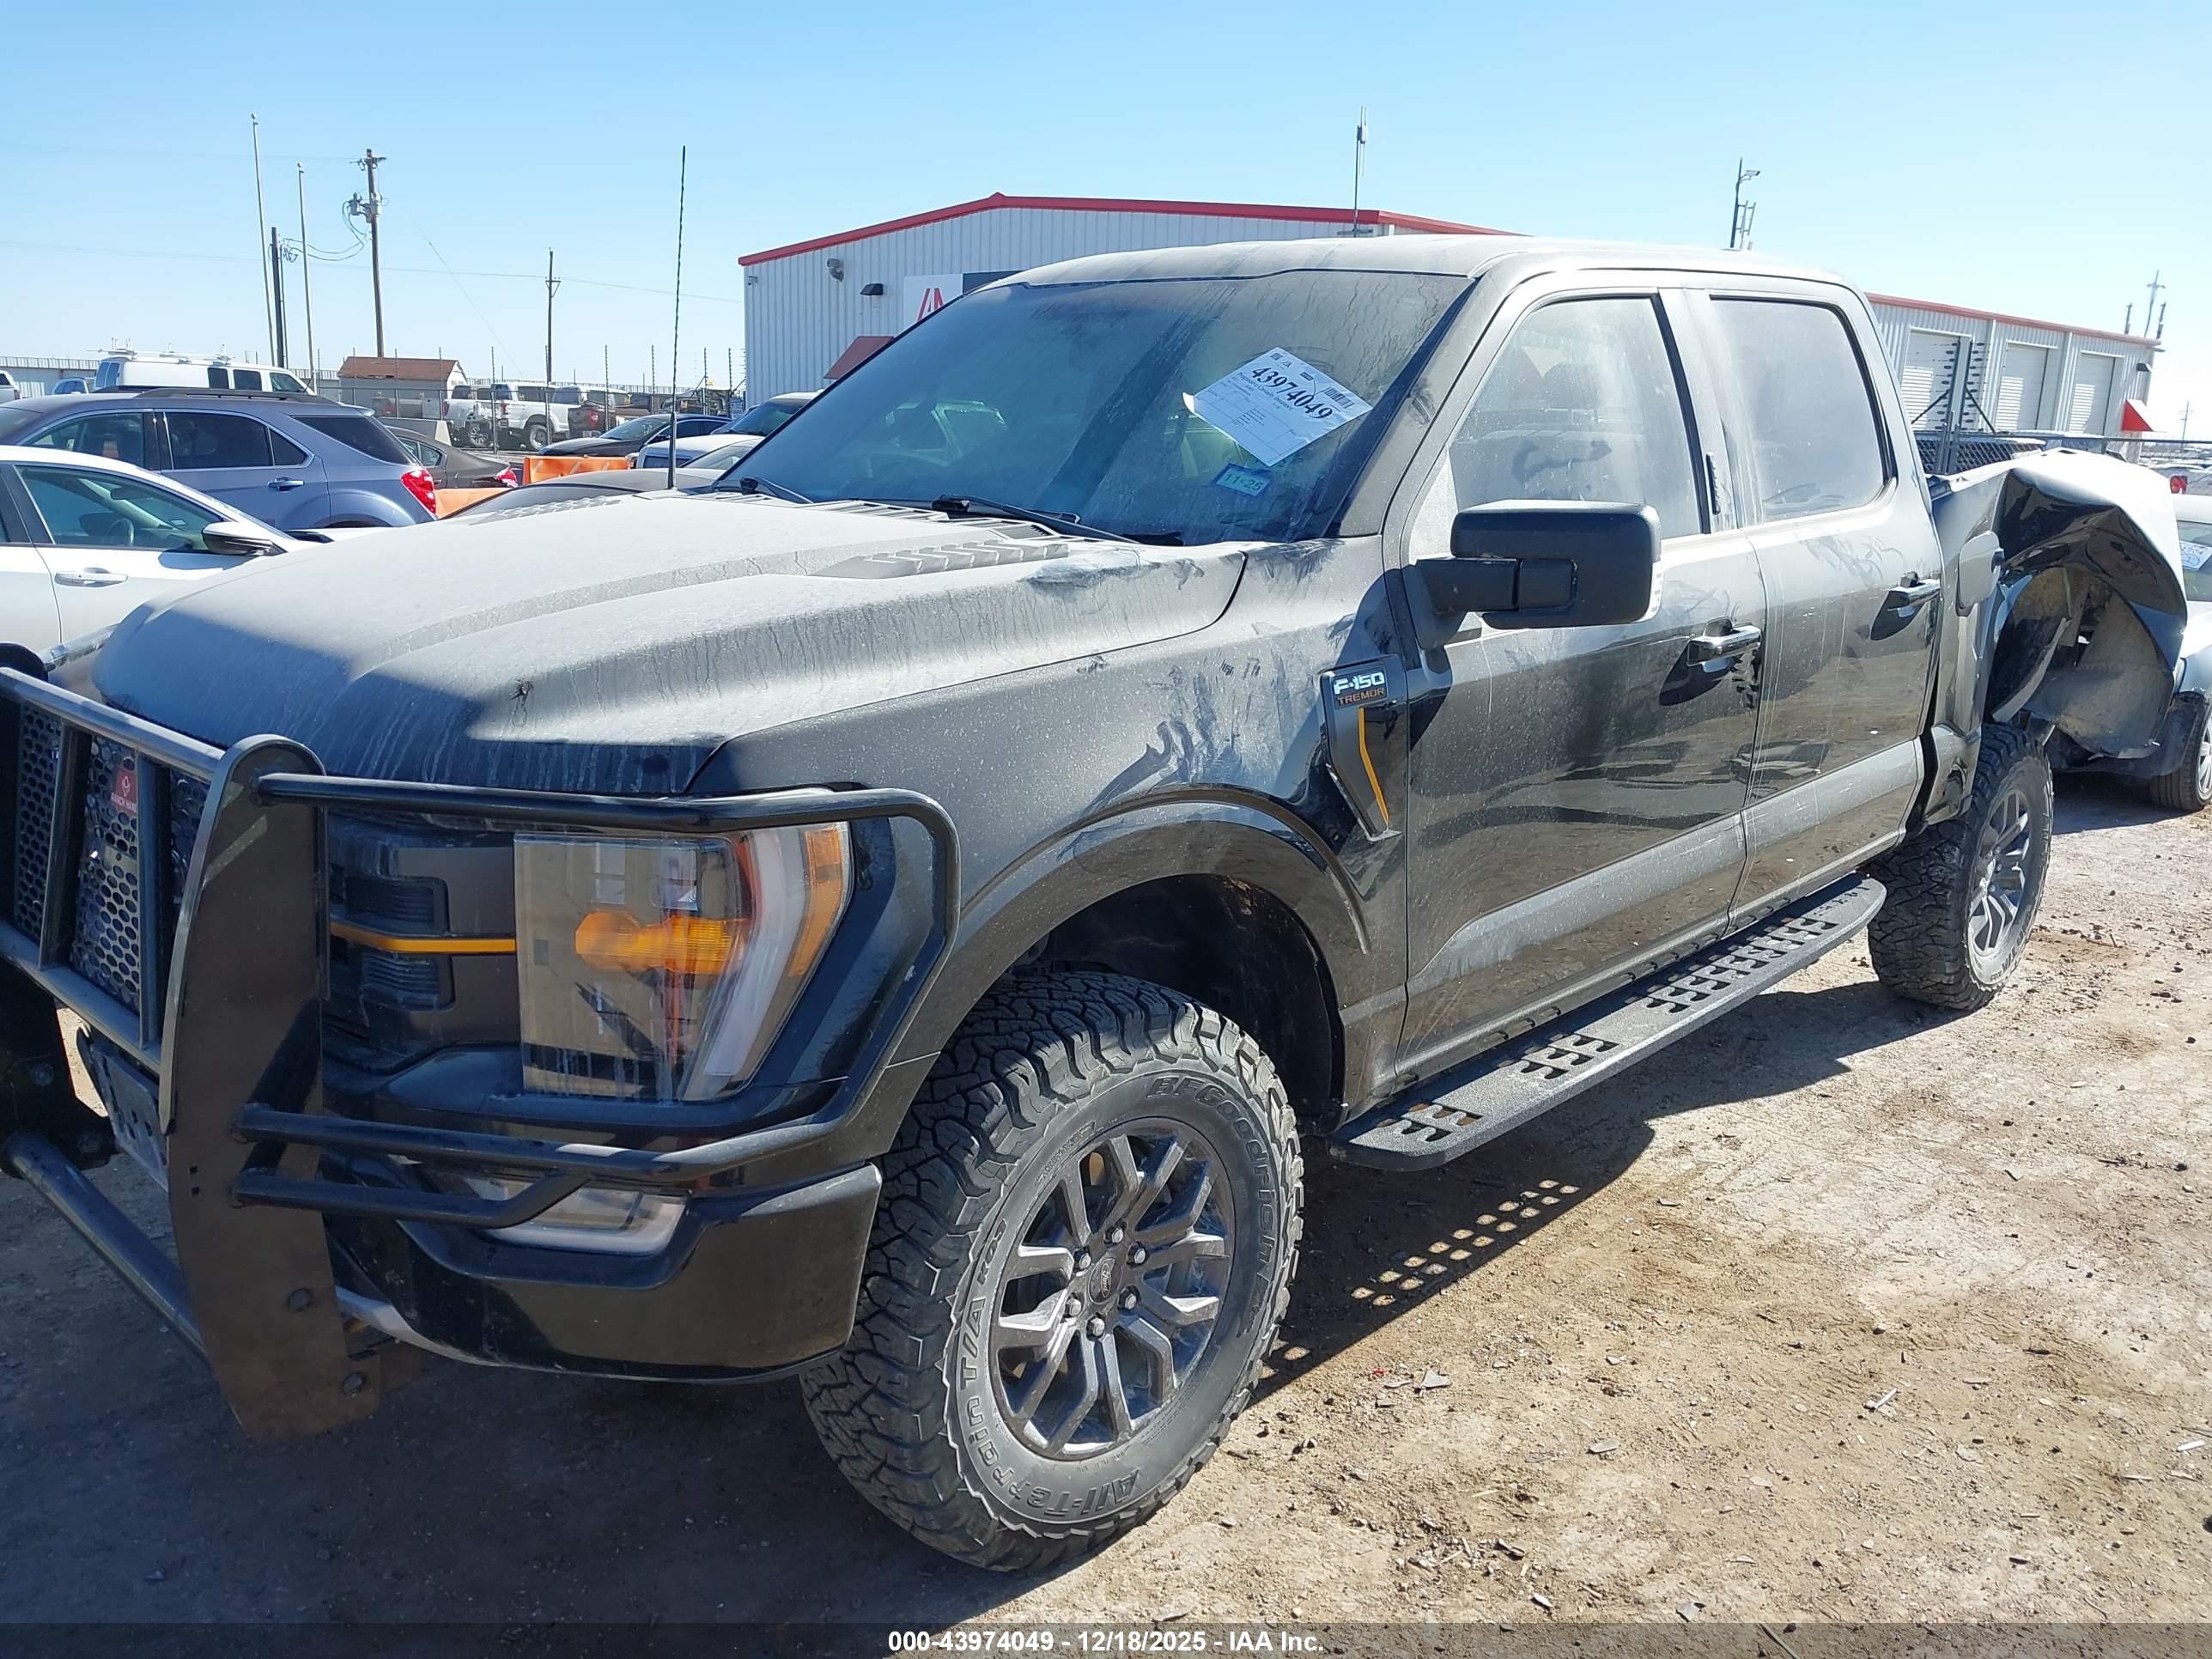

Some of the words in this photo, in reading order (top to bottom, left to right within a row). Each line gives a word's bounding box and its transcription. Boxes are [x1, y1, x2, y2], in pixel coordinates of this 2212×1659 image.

[1251, 367, 1334, 420] 43974049
[1334, 672, 1385, 695] F-150
[1338, 687, 1384, 704] TREMOR
[1146, 1076, 1277, 1265] BFGoodrich
[960, 1297, 987, 1390] T/A
